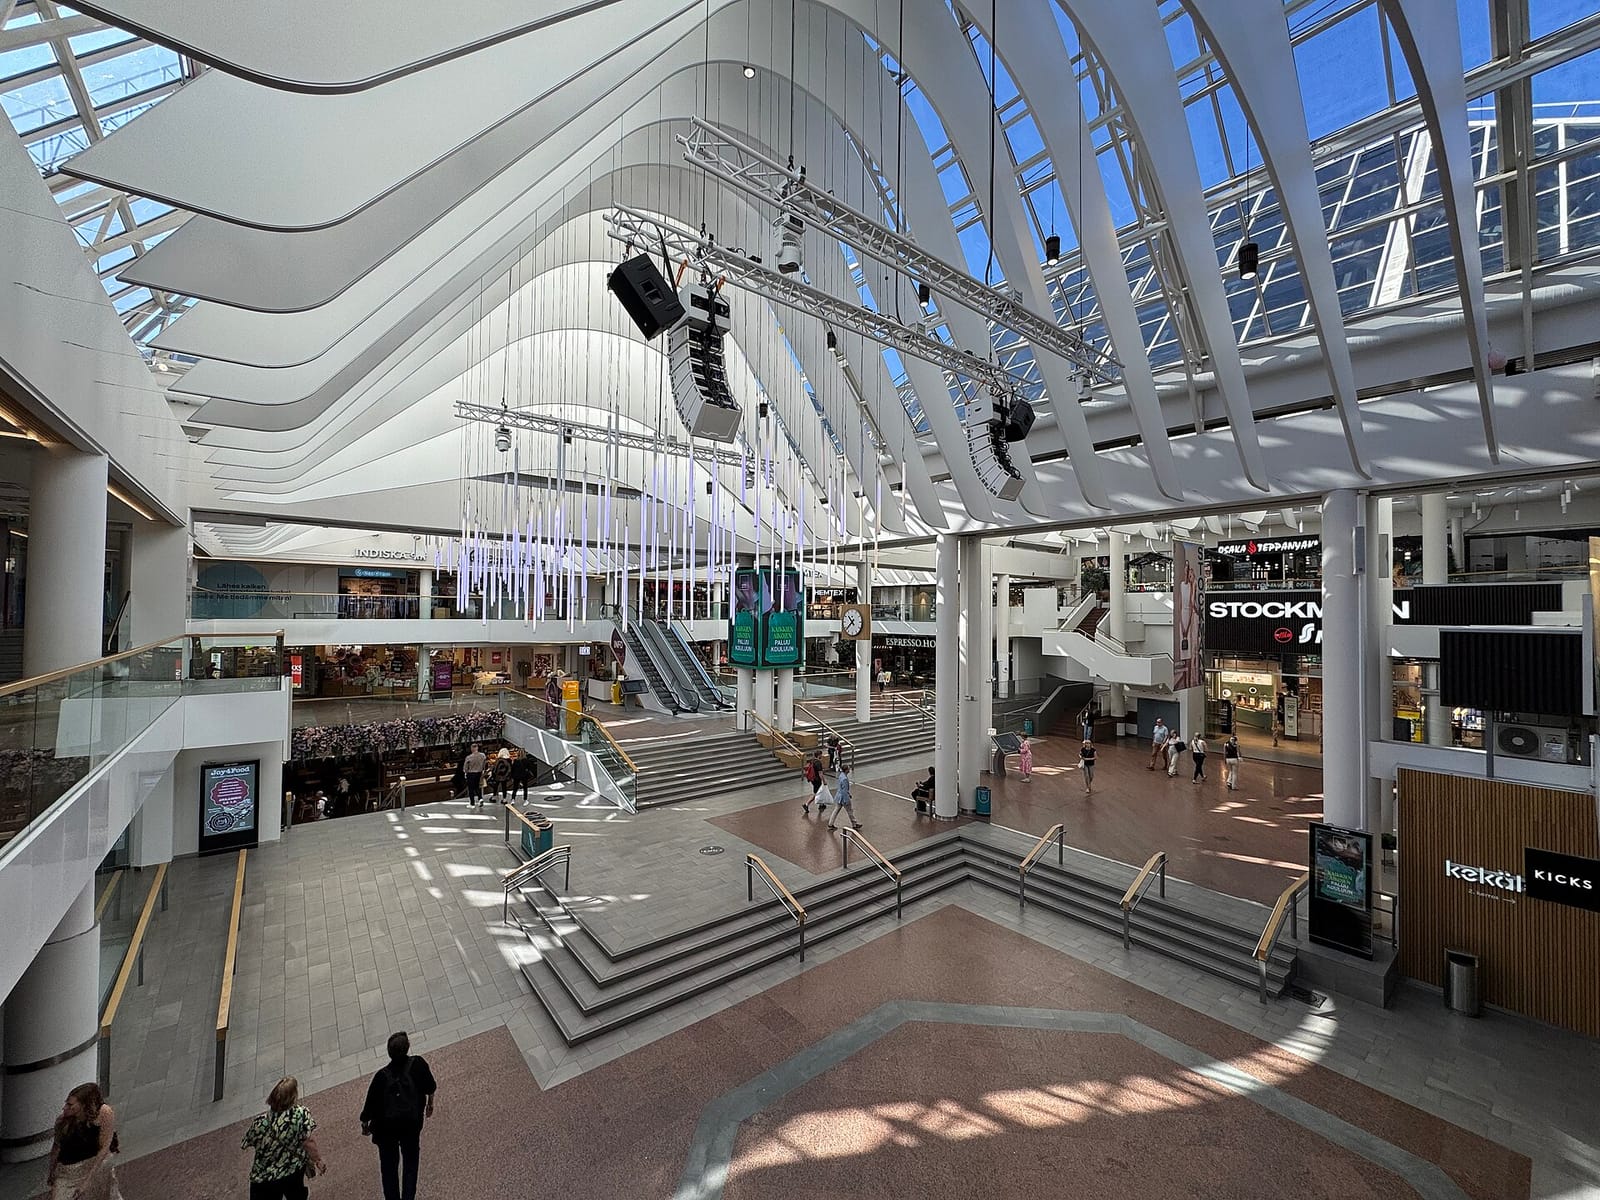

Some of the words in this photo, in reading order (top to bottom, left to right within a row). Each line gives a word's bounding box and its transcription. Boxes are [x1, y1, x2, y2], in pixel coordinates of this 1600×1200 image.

[354, 548, 407, 560] INDISKA
[1218, 545, 1247, 554] OSAKA
[814, 589, 843, 597] HEMTEX
[885, 638, 921, 647] ESPRESSO
[1534, 869, 1593, 890] KICKS
